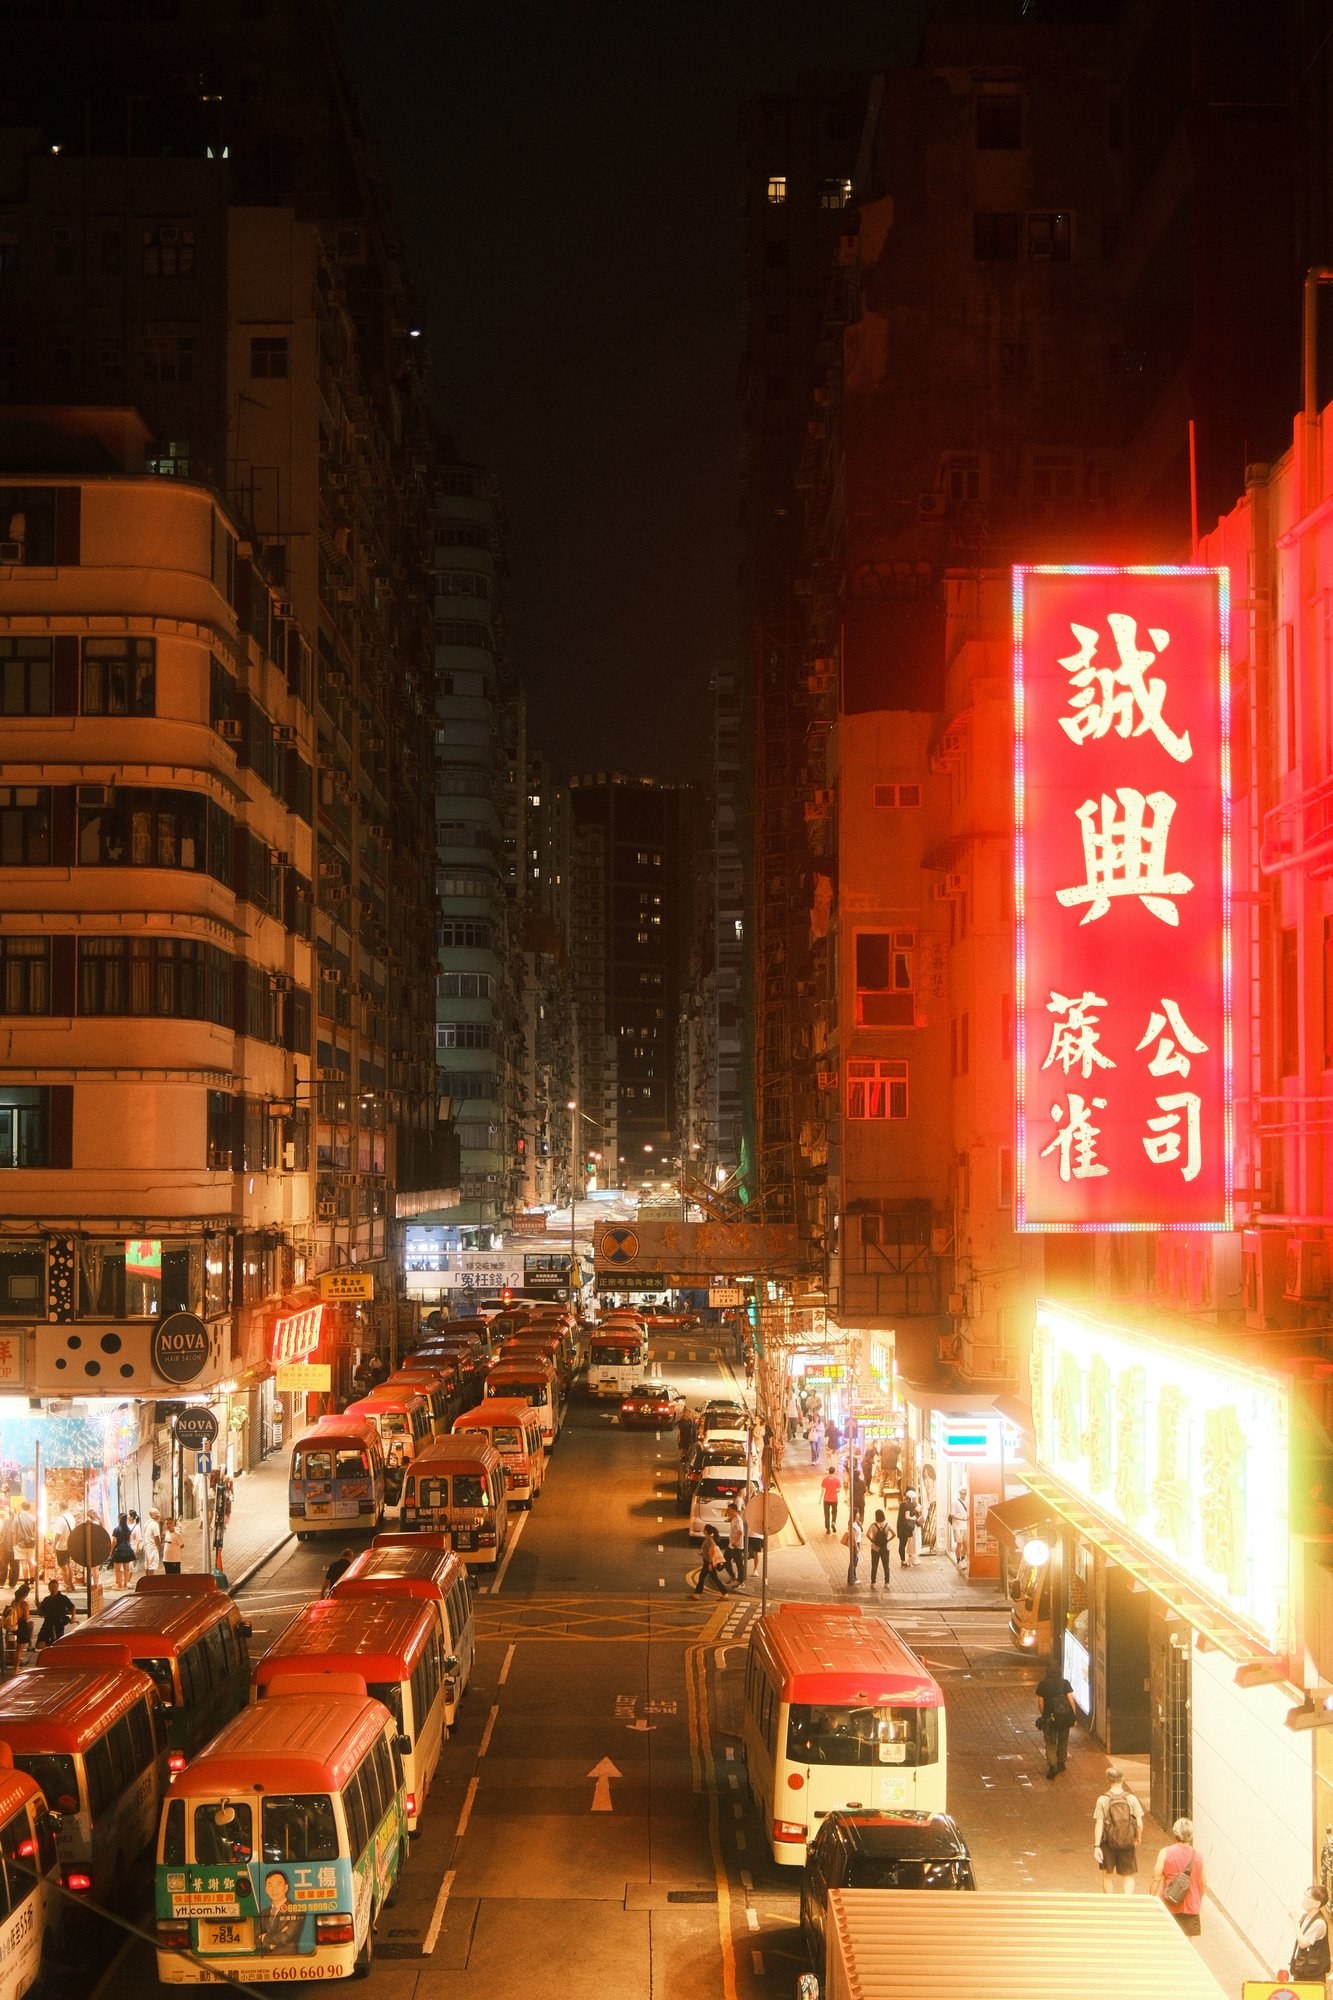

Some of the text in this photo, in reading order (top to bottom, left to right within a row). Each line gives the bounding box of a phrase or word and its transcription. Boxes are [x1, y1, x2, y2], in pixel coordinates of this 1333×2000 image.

[1056, 613, 1195, 928] 誠興
[1135, 999, 1210, 1182] 公司
[161, 1333, 205, 1350] NOVA
[178, 1420, 213, 1430] NOVA
[192, 1878, 235, 1892] 葉謝鄧
[294, 1867, 337, 1888] 工傷
[175, 1906, 227, 1916] ytt.com.hk
[219, 1926, 233, 1935] SW
[212, 1934, 240, 1944] 7834
[272, 1964, 344, 1980] 660 660 90
